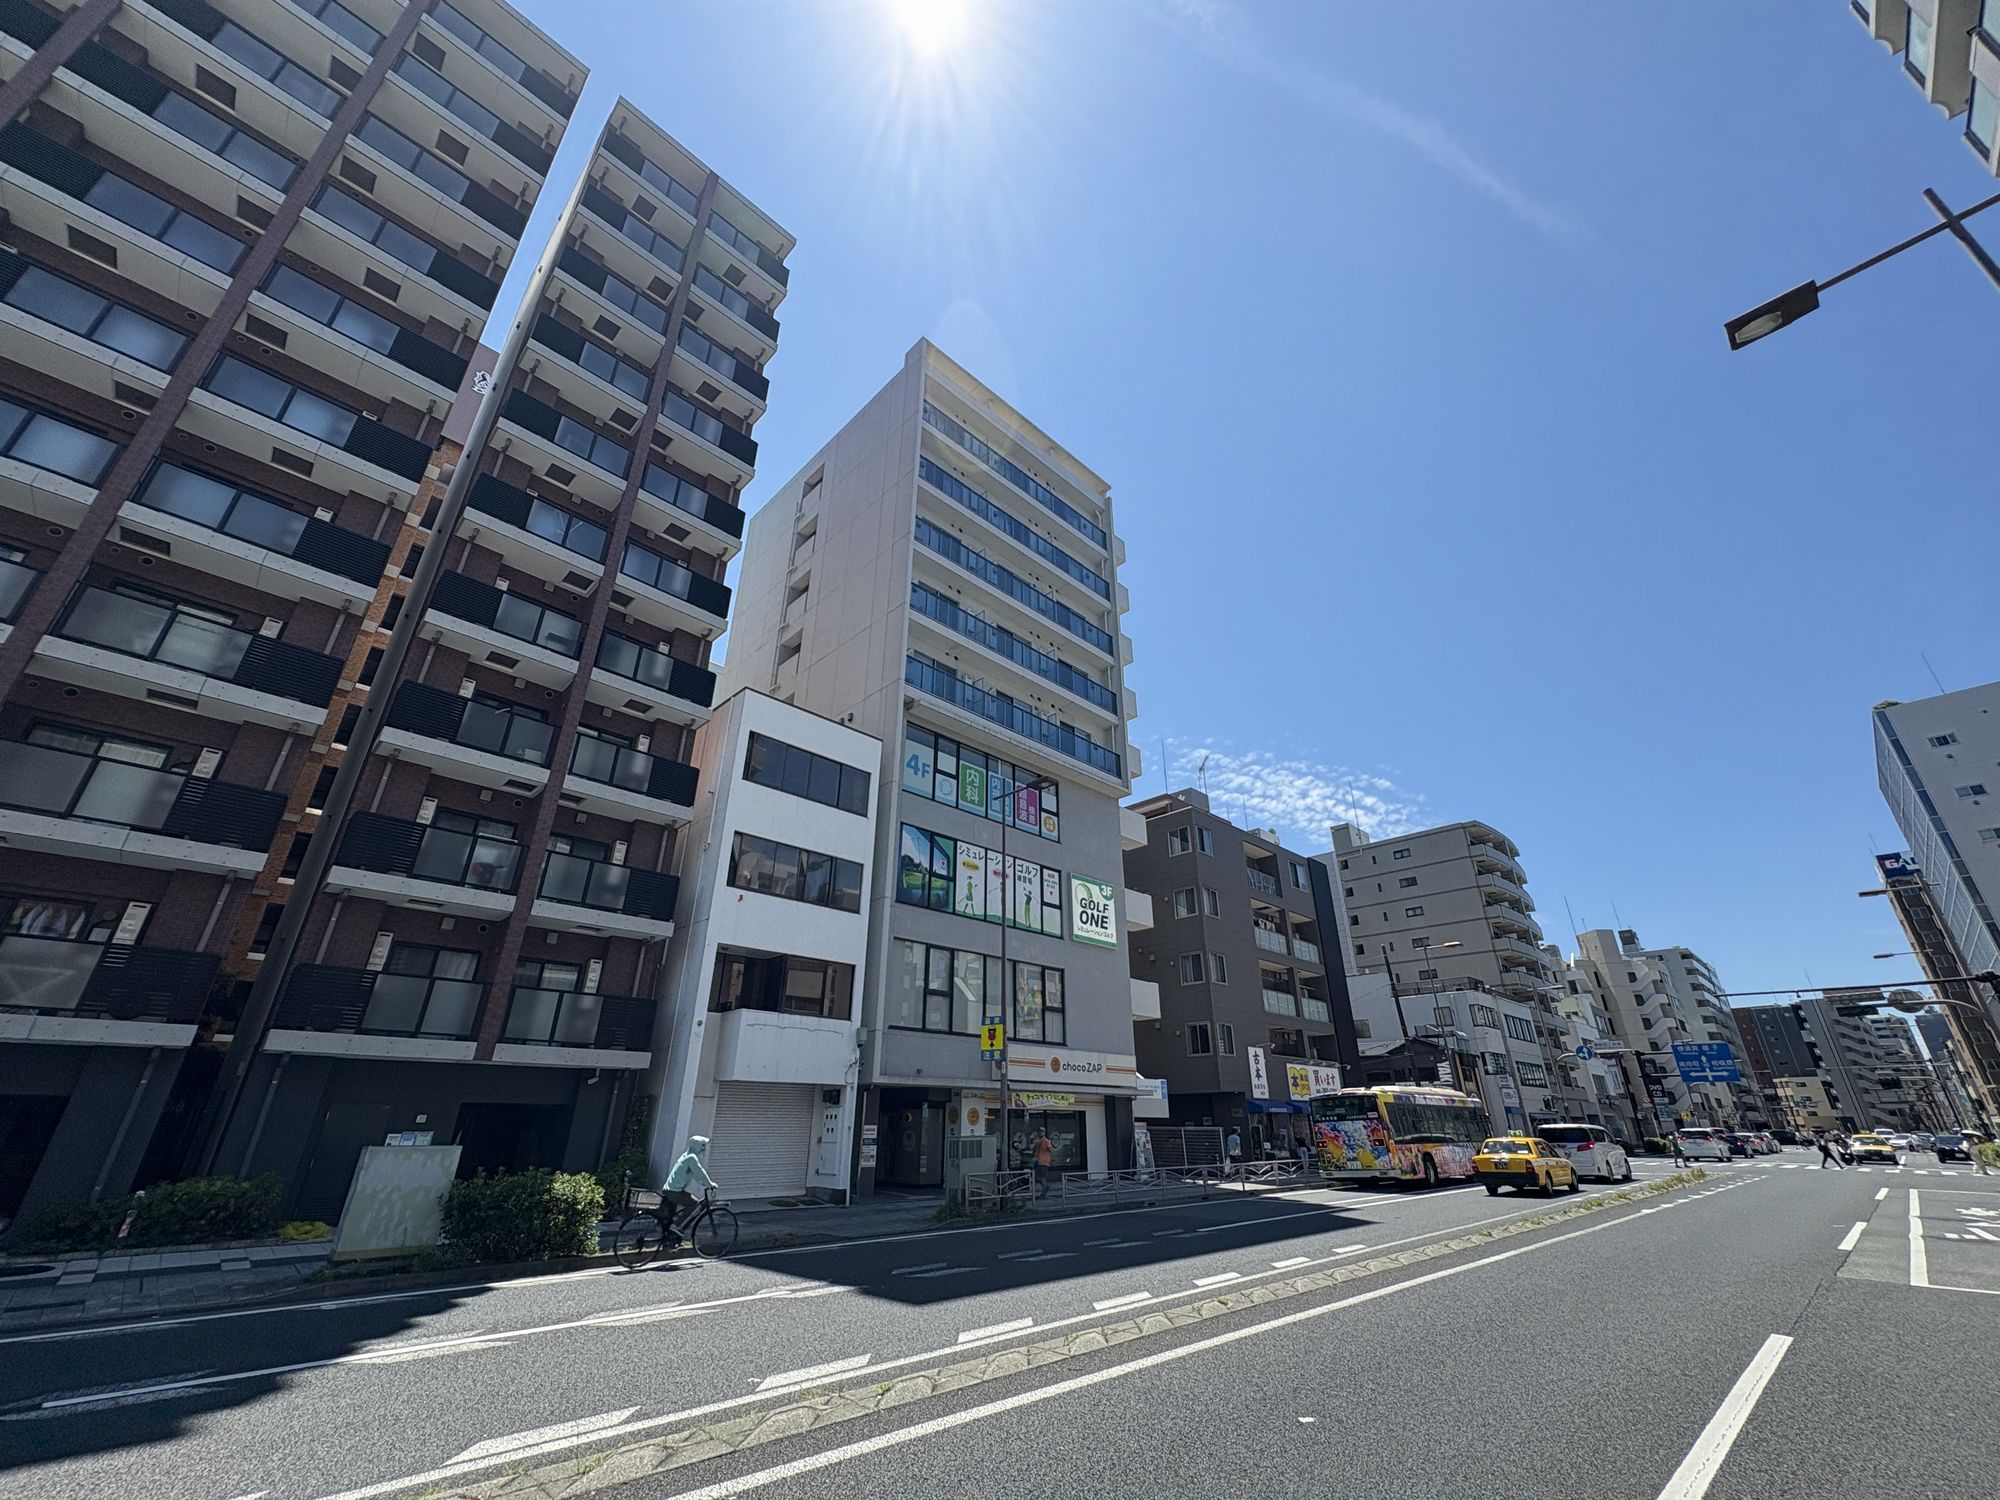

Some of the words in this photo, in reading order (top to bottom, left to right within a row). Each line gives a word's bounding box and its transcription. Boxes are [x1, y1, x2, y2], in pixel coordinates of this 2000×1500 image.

[906, 754, 931, 778] 4F
[966, 769, 980, 804] 内科
[1100, 885, 1113, 897] 3F
[1080, 897, 1109, 914] GOLF
[1080, 910, 1109, 930] ONE
[1062, 1061, 1103, 1073] chocoZAP
[1252, 1050, 1262, 1081] 古本
[1290, 1073, 1300, 1089] 本
[1312, 1070, 1336, 1087] 買います
